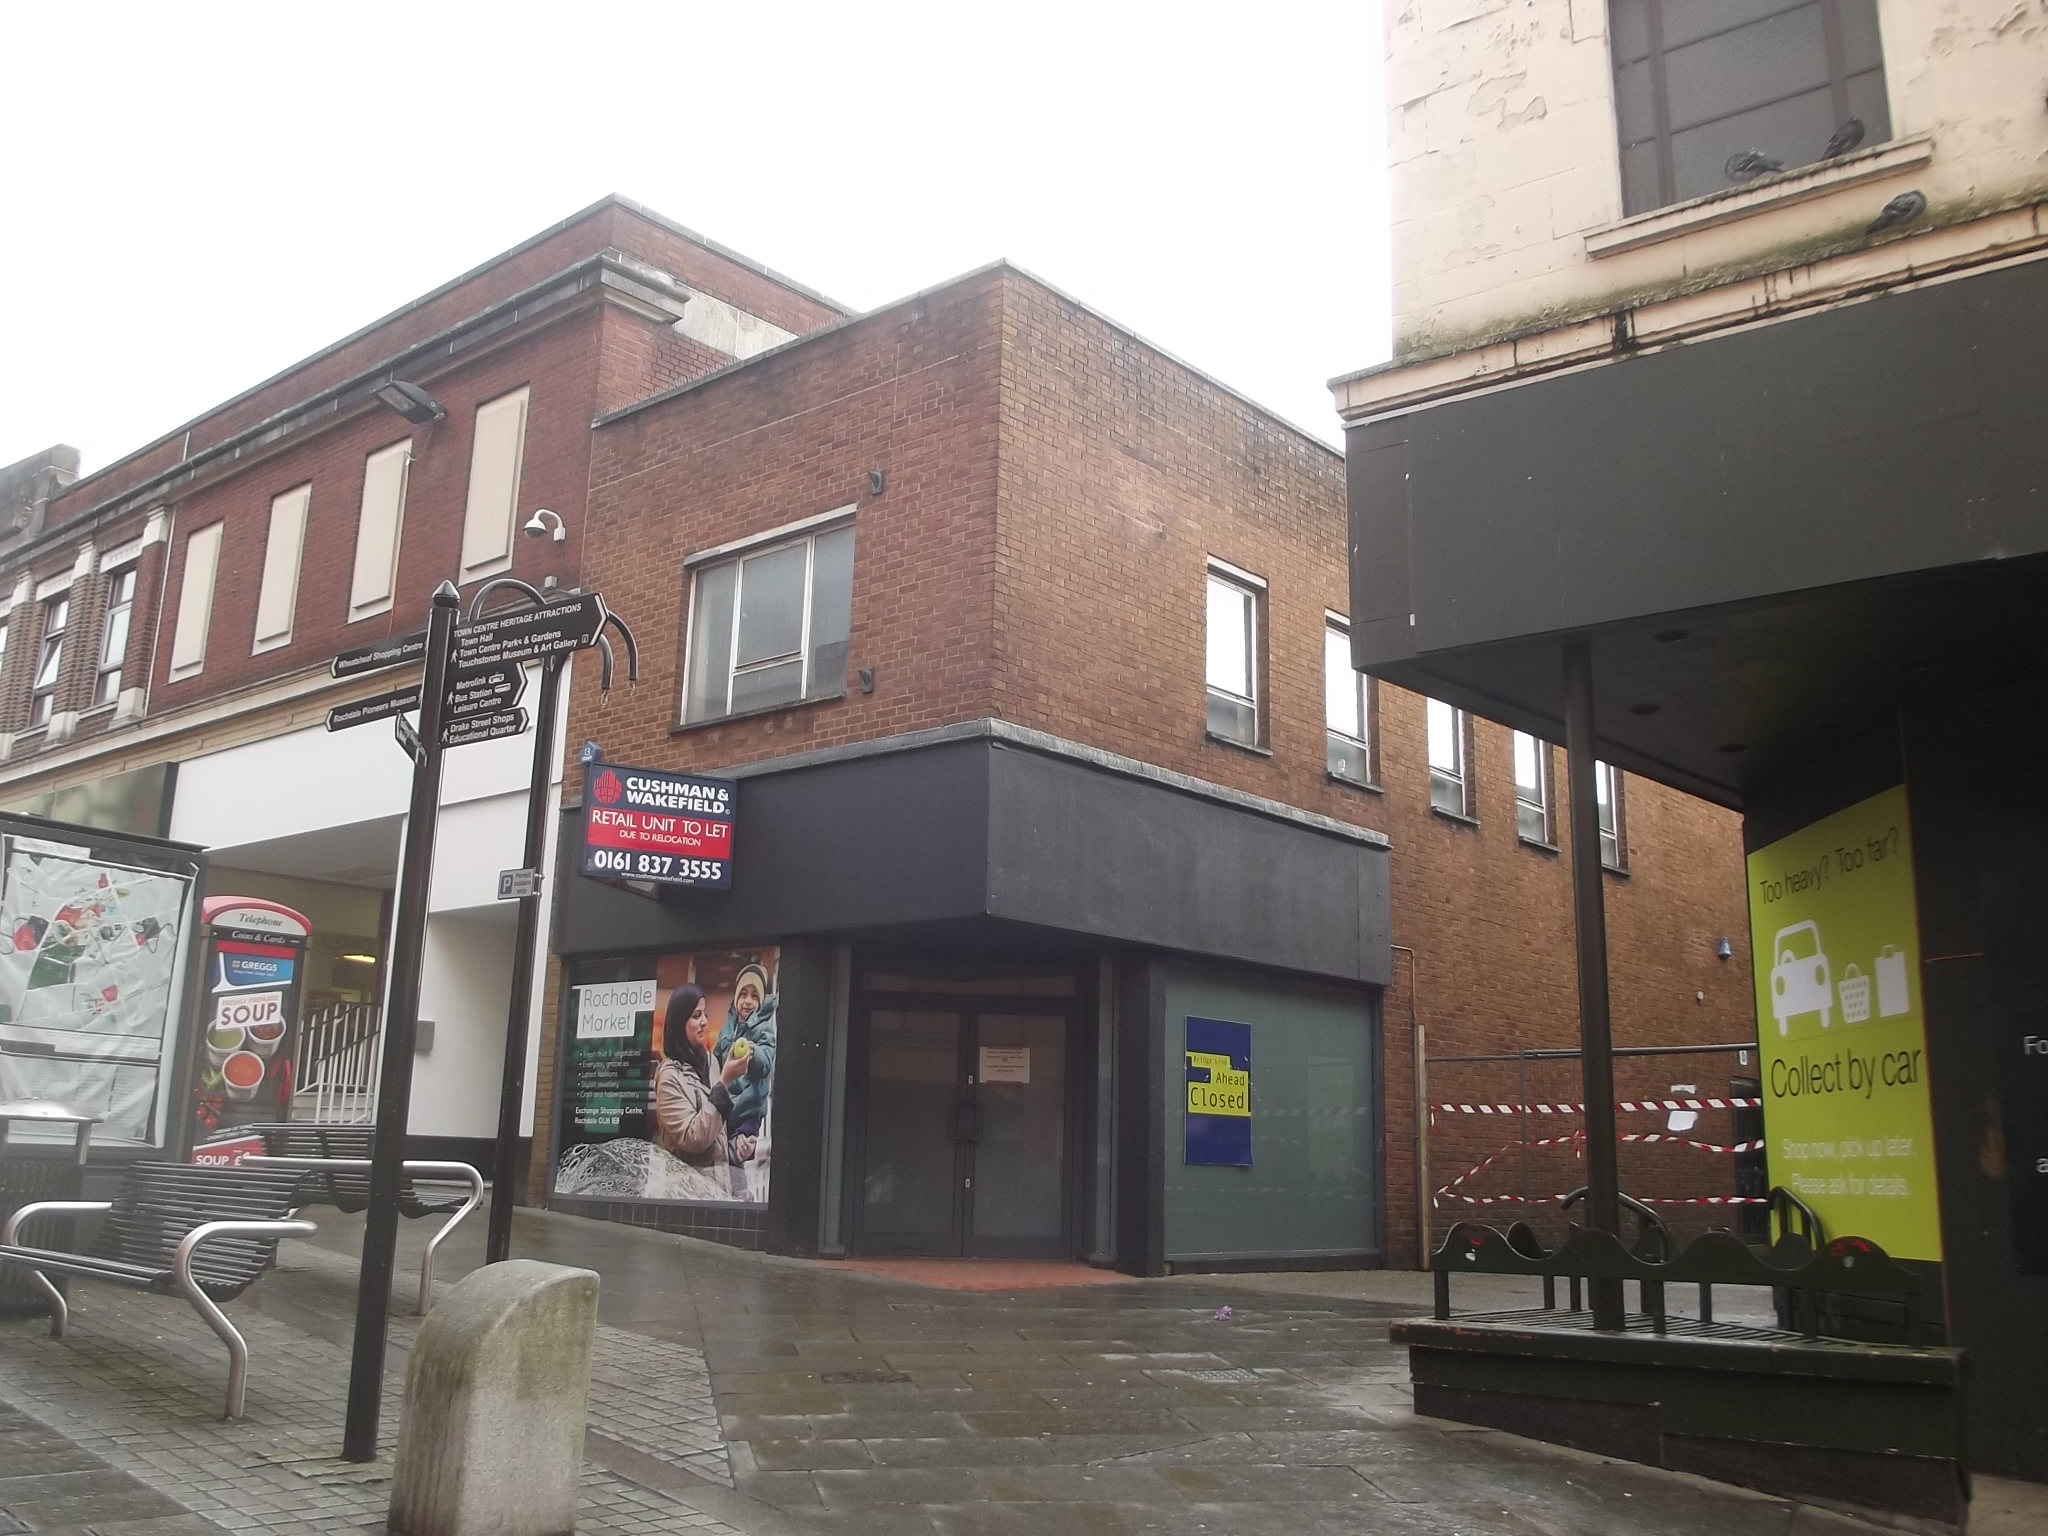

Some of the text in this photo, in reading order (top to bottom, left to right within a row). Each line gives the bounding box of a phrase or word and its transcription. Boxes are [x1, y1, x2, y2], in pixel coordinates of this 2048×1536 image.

[454, 603, 582, 638] TOWN CENTRE HERITAGE ATTRACTIONS
[460, 630, 562, 658] Town Centre Parks & Gardens
[461, 633, 494, 647] Town Hall
[338, 642, 424, 668] Wheatsheaf Shopping Centre
[458, 638, 578, 668] Touchstones Museum & Art Gallery
[456, 676, 486, 690] Metrolink
[455, 688, 492, 702] Bus Station
[334, 696, 416, 722] Rochdale Pioneers Museum
[454, 697, 502, 714] Leisure Centre
[450, 714, 514, 732] Drake Street Shops
[449, 724, 516, 744] Educational Quarter
[626, 776, 730, 802] CUSHMAN &
[592, 809, 728, 838] RETAIL UNIT TO LET
[620, 830, 702, 847] DUE TO RELOCATION
[594, 850, 631, 871] 0161
[638, 854, 673, 875] 837
[678, 858, 722, 880] 3555
[1760, 826, 1898, 904] Too heavy? Too far?
[620, 871, 694, 884] www.cushmanwakefield.com
[239, 913, 283, 926] Telephone
[232, 930, 286, 944] Coins & Cards
[242, 961, 278, 972] GREGGS
[222, 995, 278, 1006] FRESHLY PREPARED
[584, 986, 652, 1008] Rochdale
[222, 1002, 278, 1026] SOUP
[582, 1012, 630, 1032] Market
[614, 1050, 641, 1058] vegetables
[1194, 1056, 1212, 1064] Bridge
[1216, 1072, 1244, 1086] Ahead
[1771, 1048, 1920, 1099] Collect by car
[604, 1091, 640, 1099] haberdashery
[1190, 1086, 1244, 1110] Closed
[574, 1116, 598, 1124] Rochdale
[576, 1107, 599, 1115] Exchange
[600, 1107, 624, 1115] Shopping
[1783, 1138, 1808, 1162] Shop
[1840, 1138, 1862, 1162] pick
[1868, 1139, 1882, 1160] up
[196, 1155, 230, 1166] SOUP
[1792, 1173, 1825, 1194] Please
[1828, 1174, 1846, 1194] ask
[1848, 1173, 1865, 1194] for
